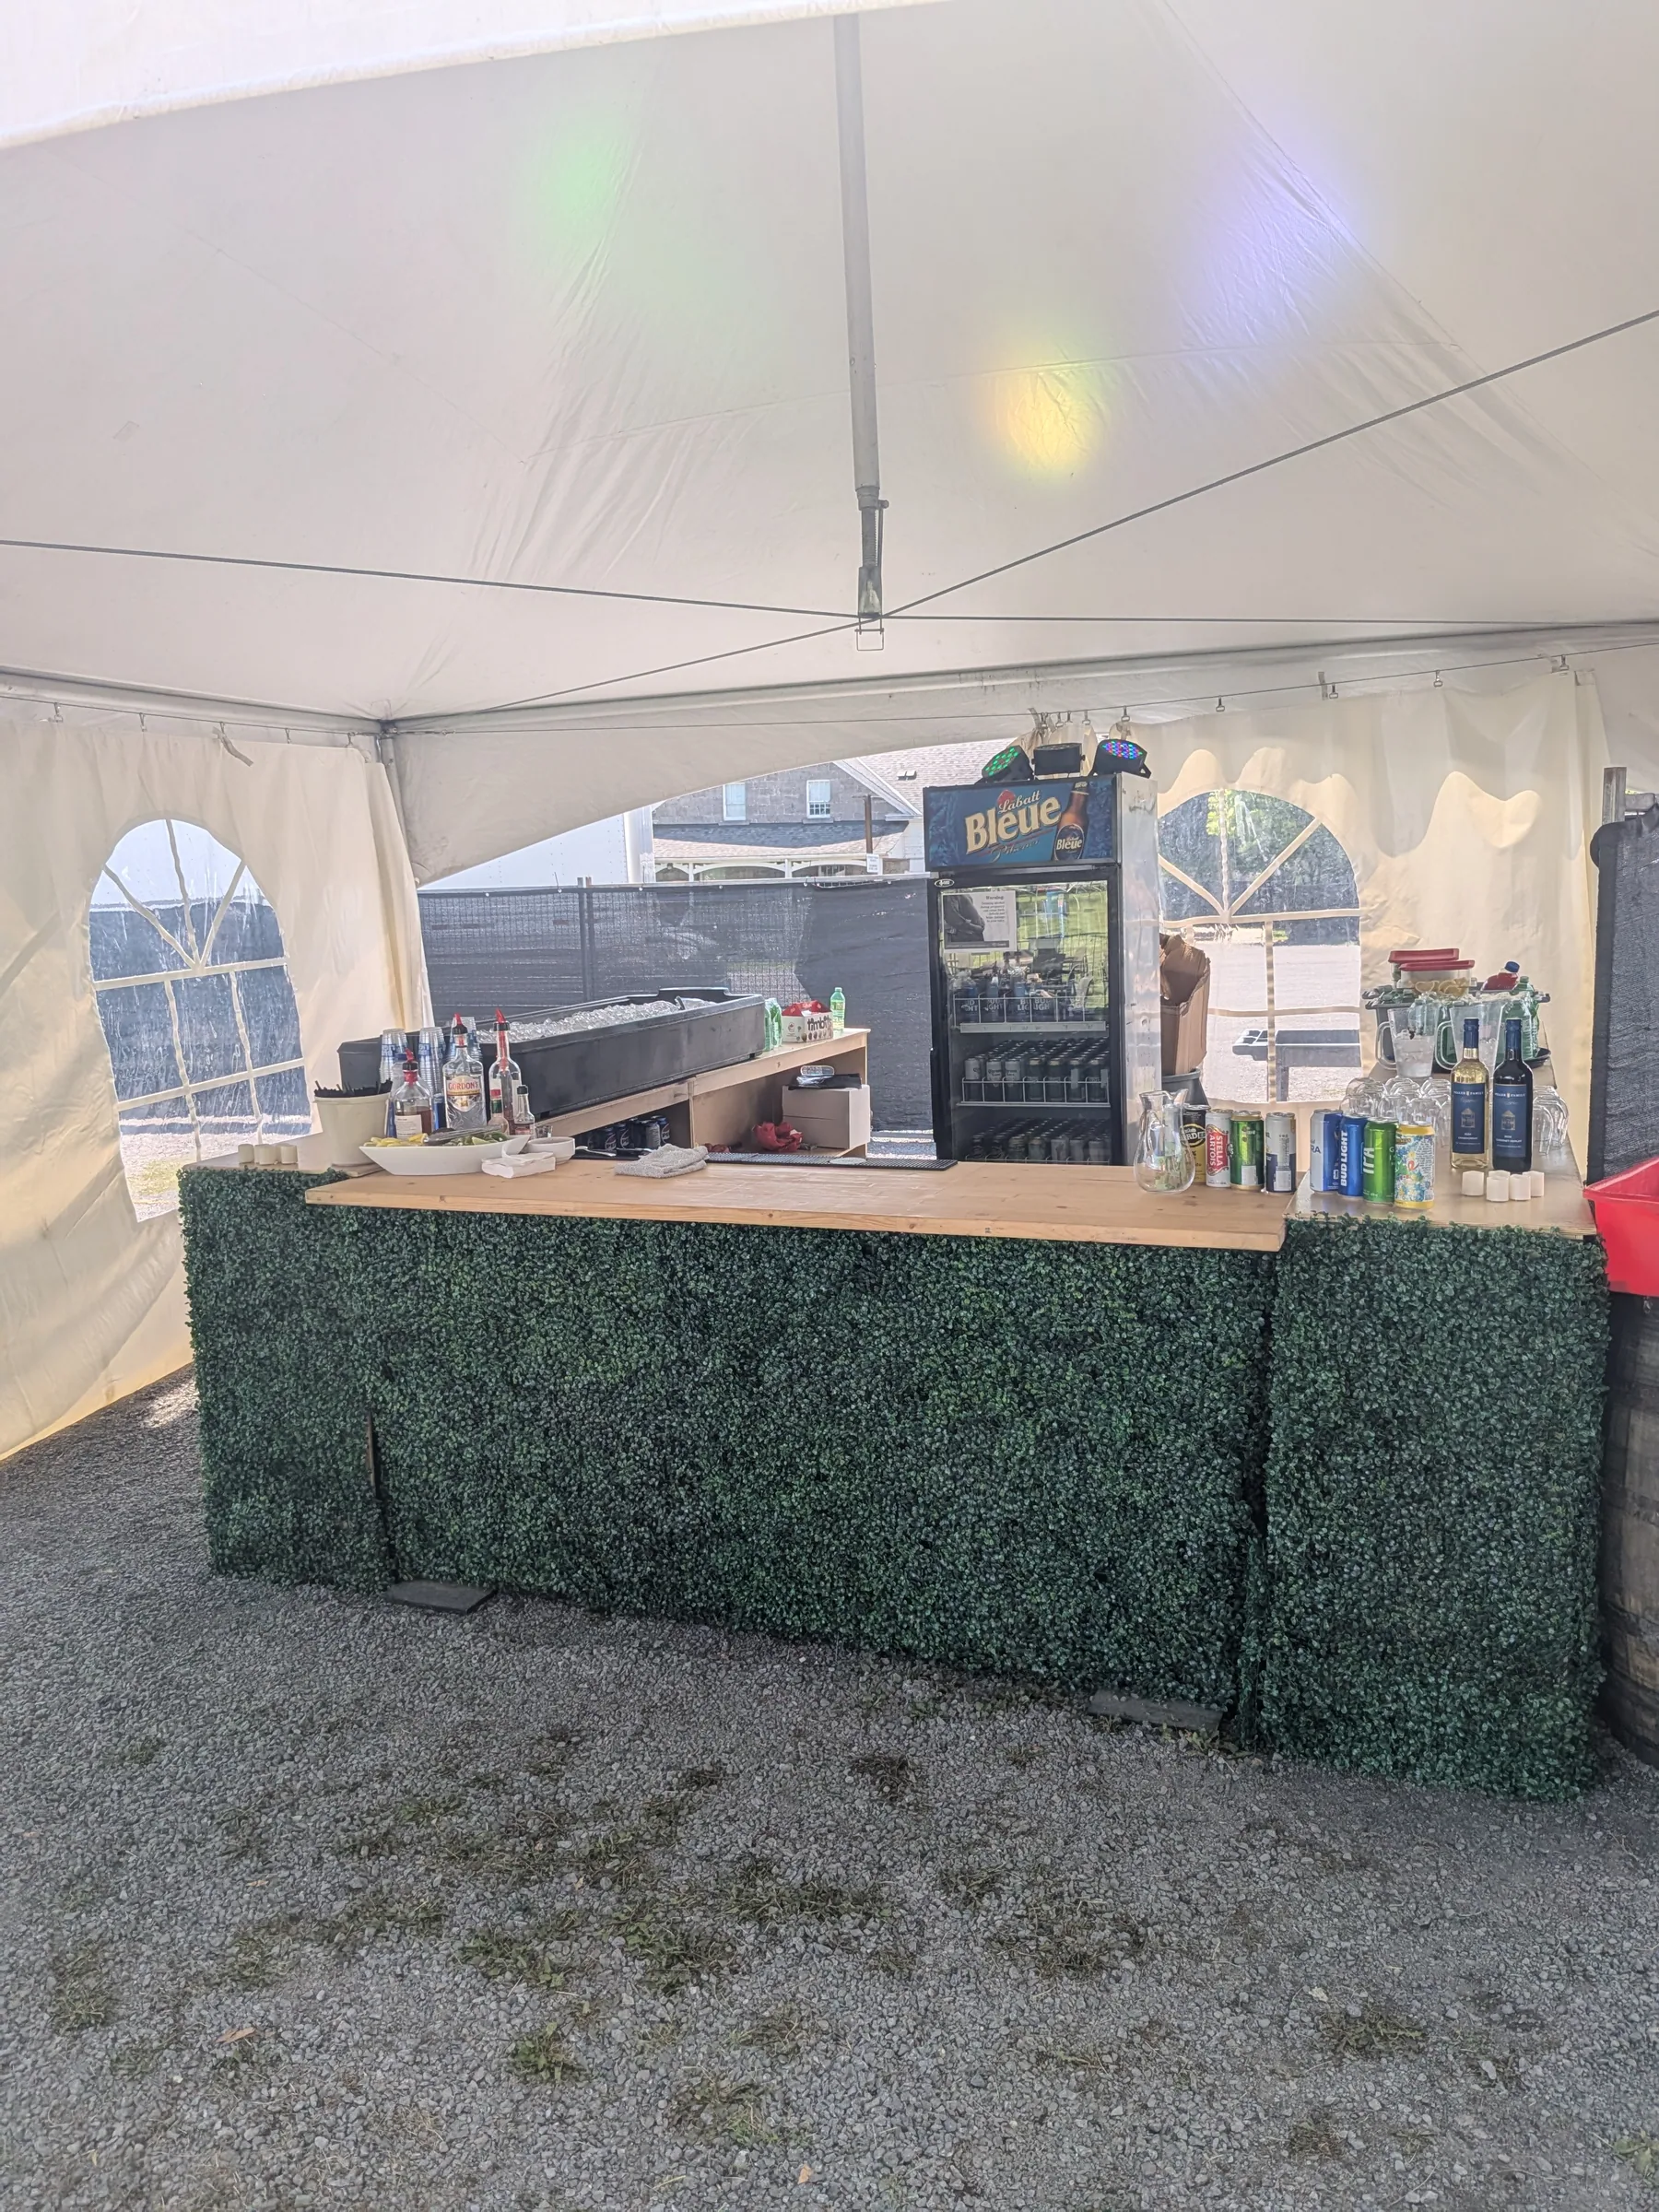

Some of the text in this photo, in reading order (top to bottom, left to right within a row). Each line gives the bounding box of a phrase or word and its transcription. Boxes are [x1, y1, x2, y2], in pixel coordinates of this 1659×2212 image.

[998, 790, 1041, 813] Labatt
[965, 797, 1062, 854] Bleue
[448, 1080, 478, 1091] GORDON'S
[1216, 1135, 1224, 1167] STELLA
[1340, 1162, 1348, 1187] BUD
